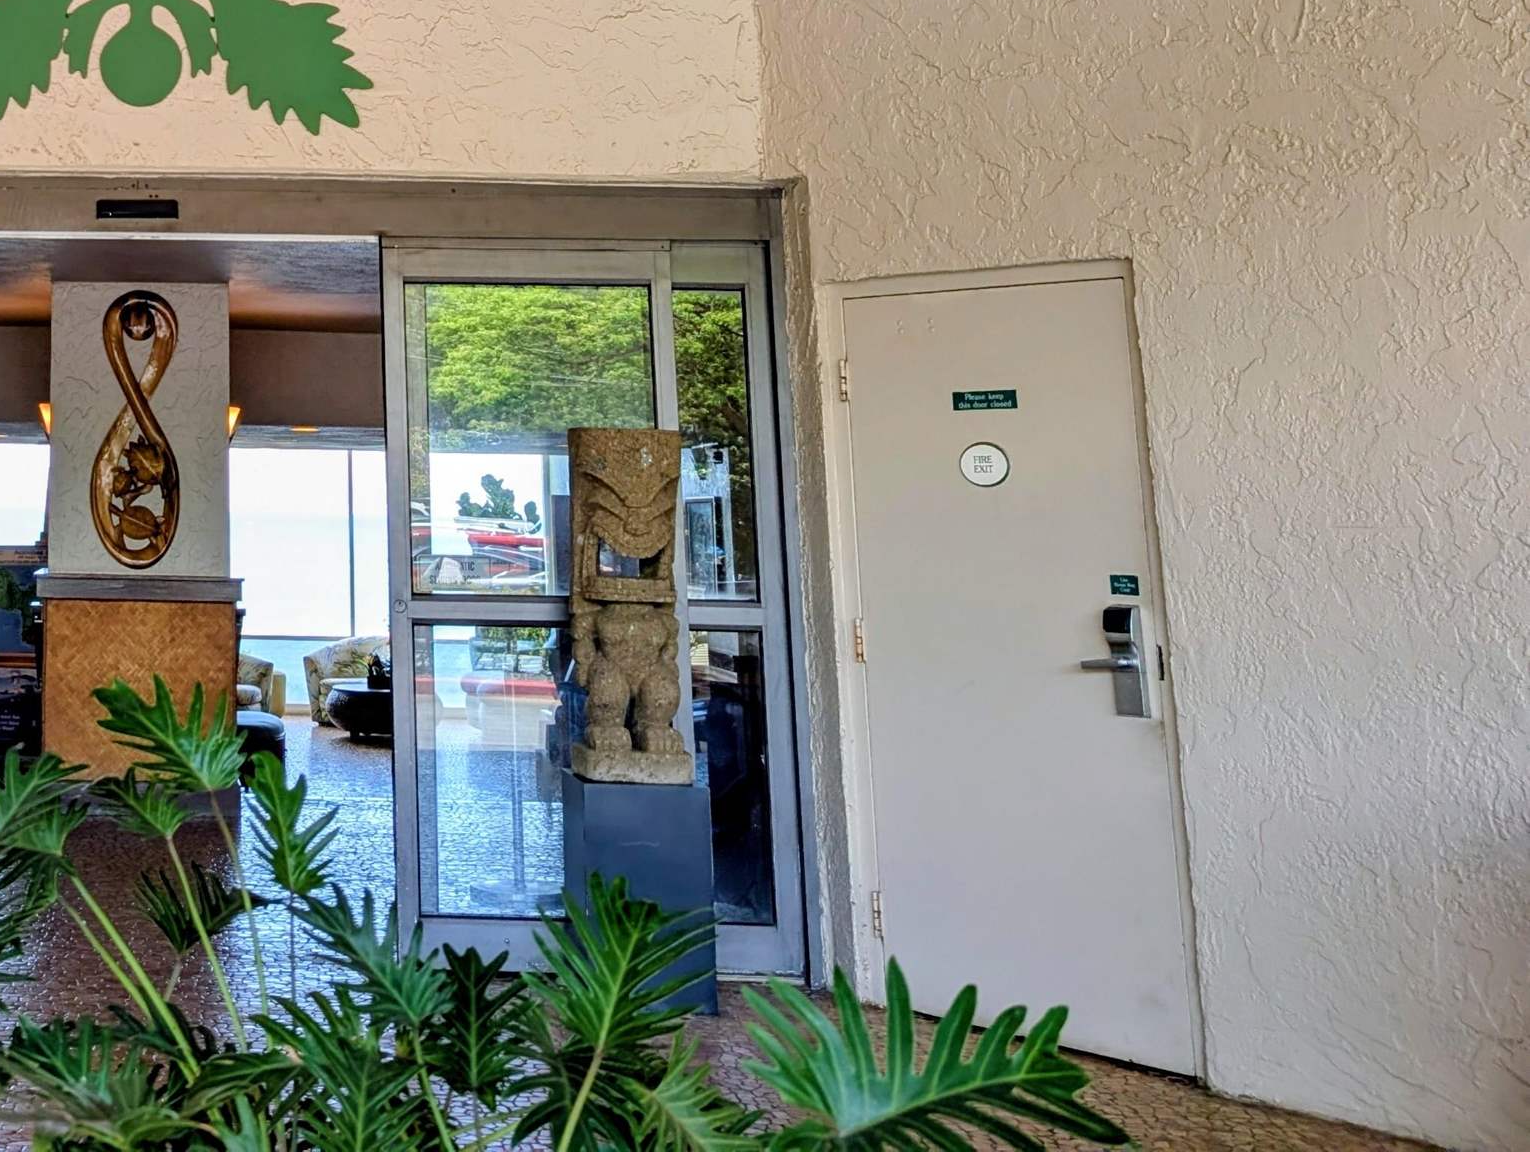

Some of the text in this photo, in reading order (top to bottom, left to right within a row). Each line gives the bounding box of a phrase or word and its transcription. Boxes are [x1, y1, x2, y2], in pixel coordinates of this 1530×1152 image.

[964, 393, 986, 401] Please
[958, 399, 1012, 409] this door closed
[973, 455, 992, 464] FIRE
[973, 464, 993, 474] EXIT
